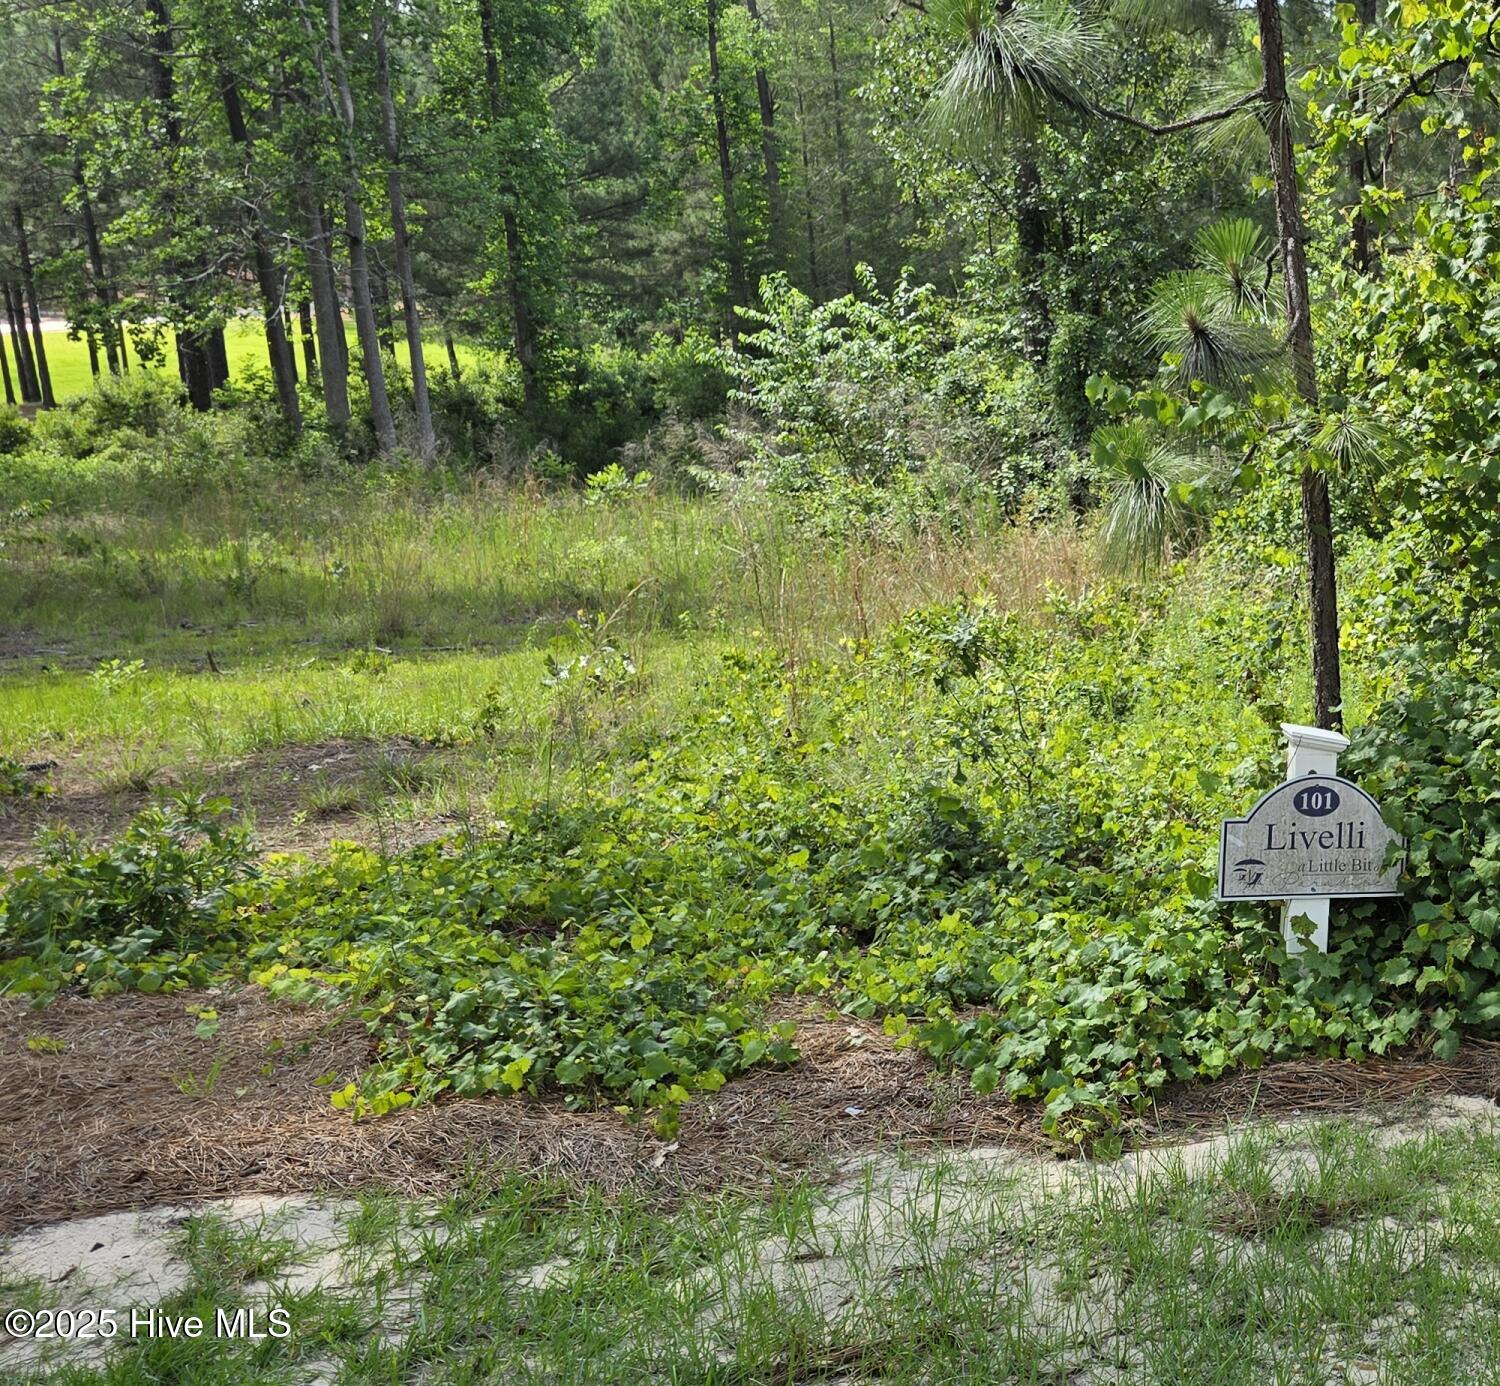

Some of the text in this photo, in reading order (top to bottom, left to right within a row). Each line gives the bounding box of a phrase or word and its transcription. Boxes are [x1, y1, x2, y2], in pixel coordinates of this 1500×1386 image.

[1301, 792, 1332, 809] 101
[1264, 821, 1366, 851] Livelli
[1297, 862, 1306, 872] a
[1308, 858, 1346, 872] Little
[1351, 858, 1372, 872] Bit
